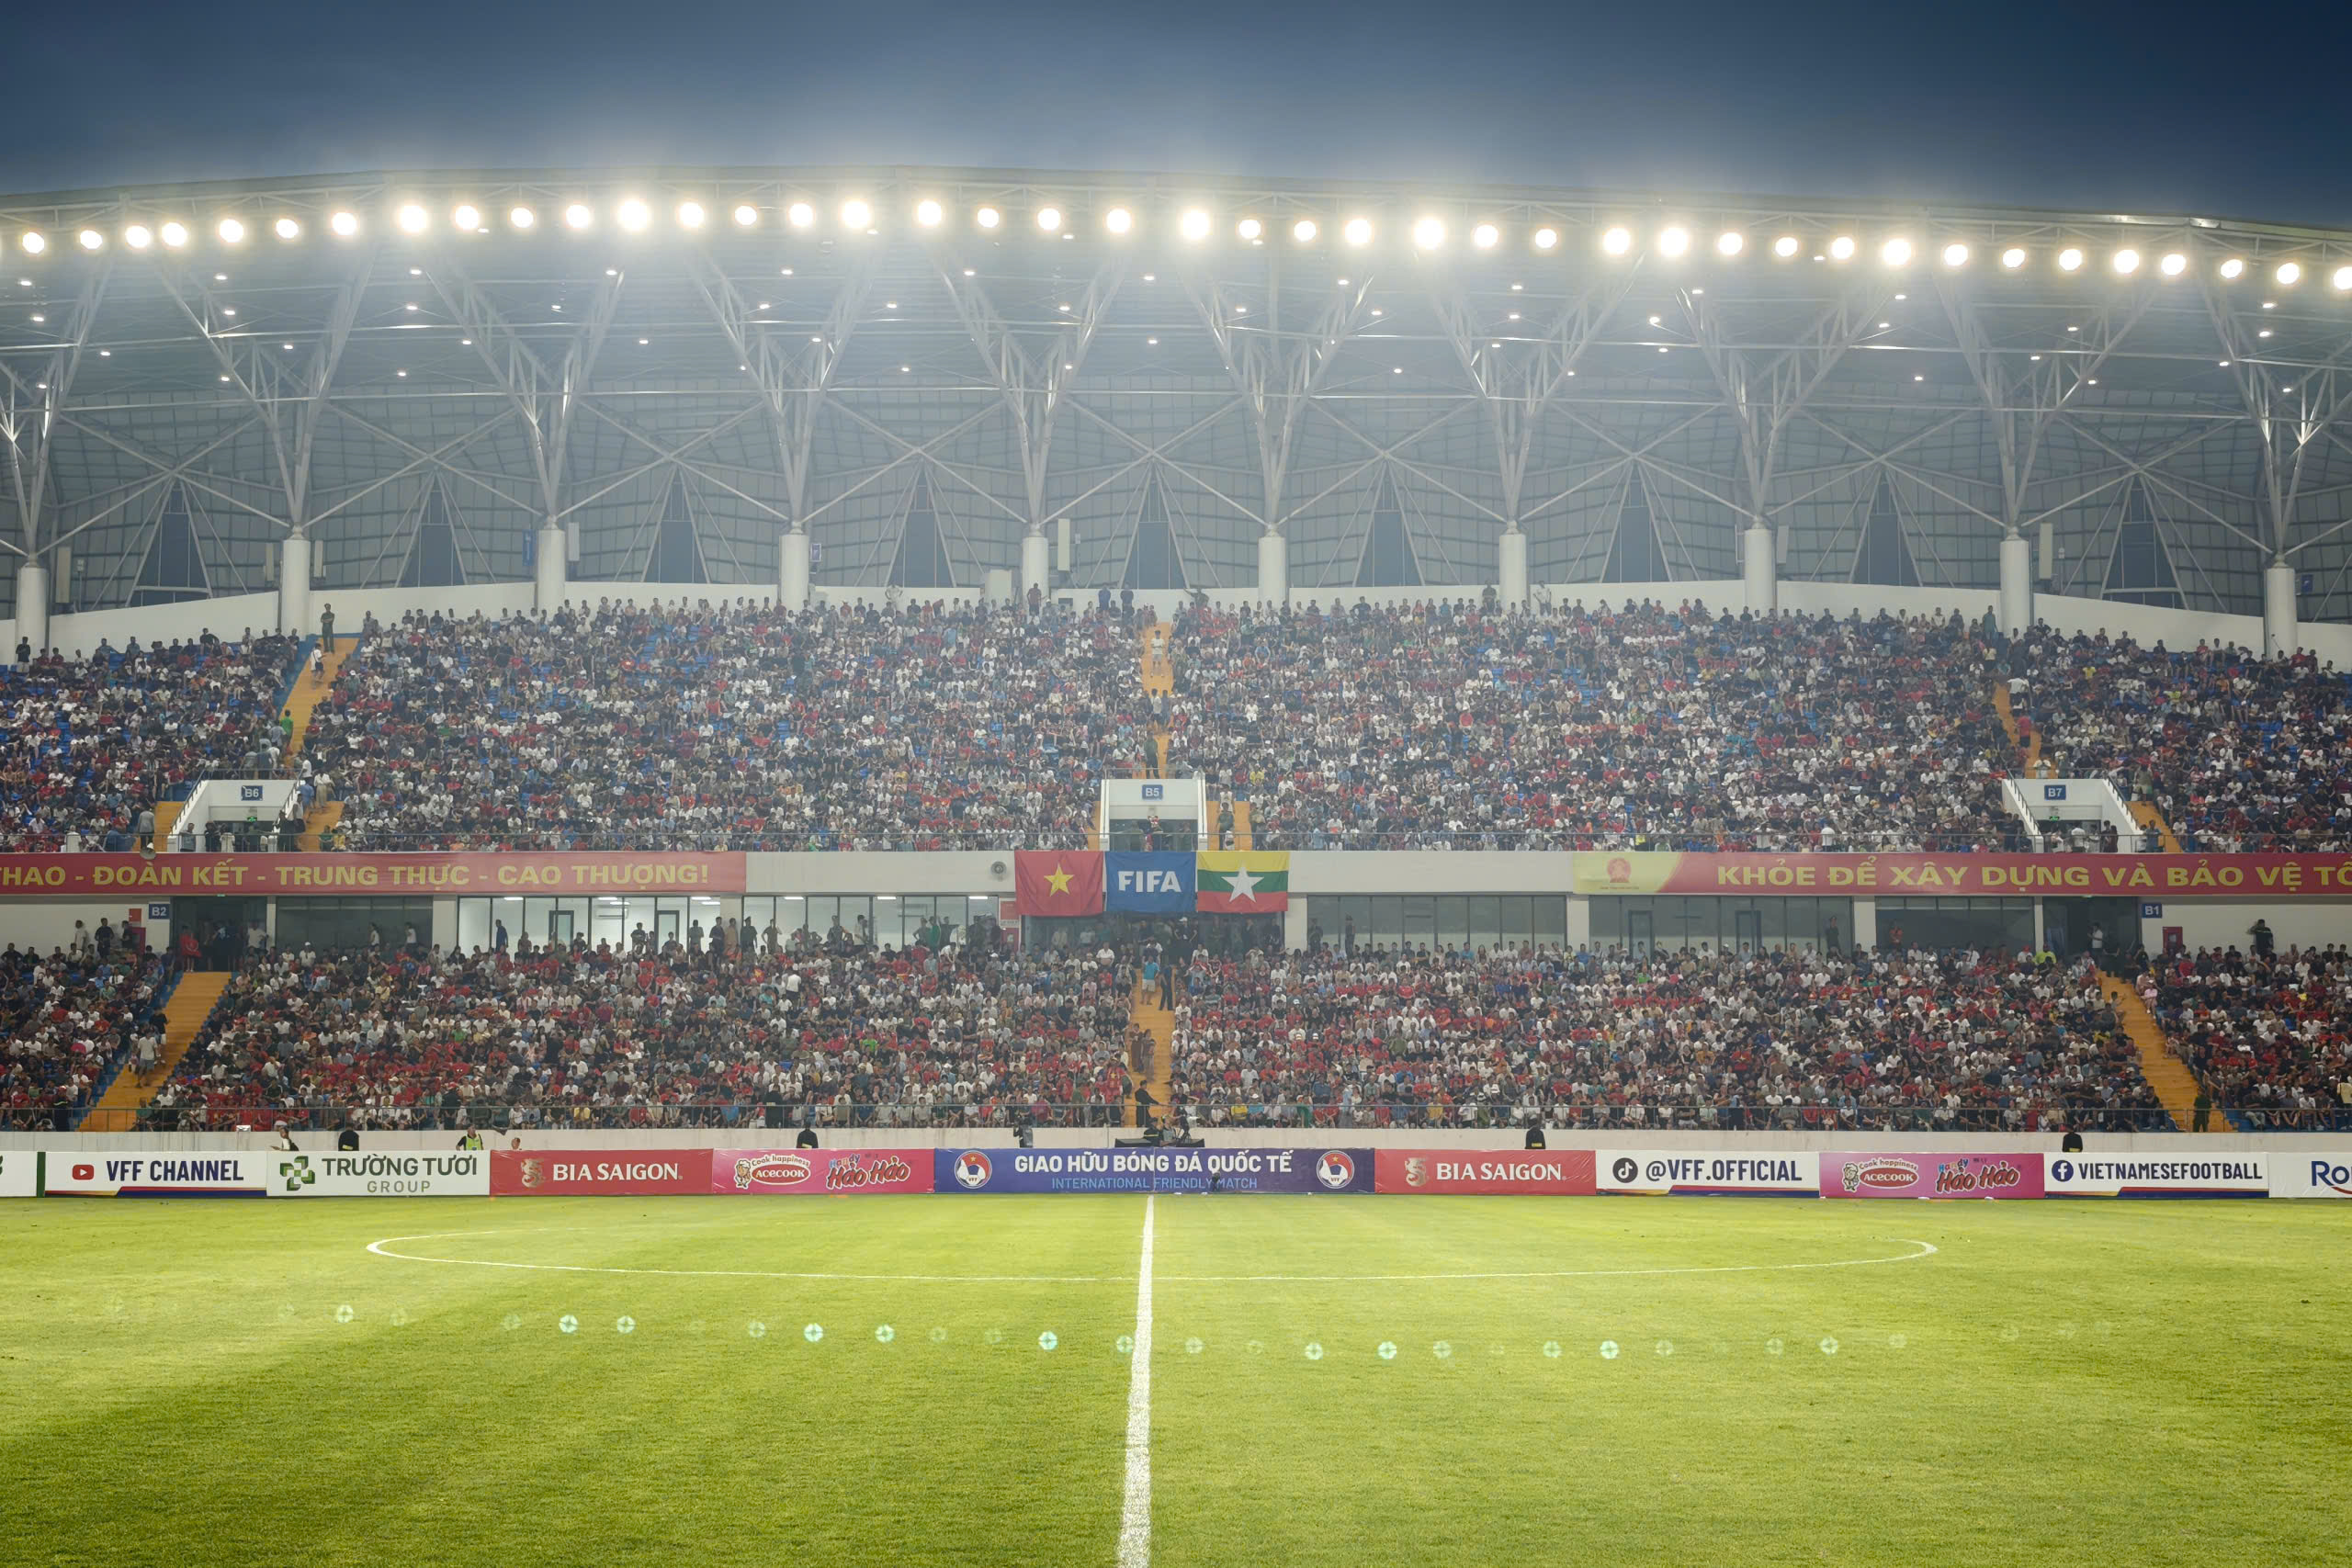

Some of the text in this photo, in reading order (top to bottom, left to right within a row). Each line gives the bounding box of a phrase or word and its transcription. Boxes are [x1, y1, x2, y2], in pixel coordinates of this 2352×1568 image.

[244, 787, 260, 798] B6
[1145, 787, 1160, 797] B5
[2048, 787, 2063, 798] B7
[0, 866, 66, 886] HAO
[93, 863, 181, 886] ĐOÀN
[192, 858, 249, 886] KẾT
[275, 867, 379, 886] TRUNG
[389, 863, 469, 891] THỰC
[498, 866, 561, 885] CAO
[571, 863, 708, 890] THƯỢNG!
[1118, 871, 1182, 893] FIFA
[1717, 859, 1815, 886] KHỎE
[1826, 856, 1877, 886] ĐỂ
[1888, 861, 1968, 886] XÂY
[1982, 863, 2089, 892] DỰNG
[2102, 862, 2154, 887] VÀ
[2167, 858, 2244, 887] BẢO
[2256, 862, 2302, 892] VỆ
[152, 907, 166, 917] B2
[2145, 906, 2159, 917] B1
[322, 1154, 477, 1176] TRƯỜNG TƯƠI
[752, 1154, 810, 1167] Cook happiness
[1014, 1148, 1294, 1174] GIAO HỮU BÓNG ĐÁ QUỐC TẾ
[1859, 1158, 1918, 1170] Cook happiness
[107, 1160, 244, 1181] VFF CHANNEL
[552, 1163, 678, 1181] BIA SAIGON
[827, 1156, 910, 1189] Hảo Hảo
[1437, 1163, 1562, 1180] BIA SAIGON
[1646, 1159, 1802, 1181] @VFF.OFFICIAL
[1936, 1161, 2020, 1192] Hảo Hảo
[2078, 1162, 2262, 1179] VIETNAMESEFOOTBALL
[2312, 1161, 2352, 1186] Ro
[367, 1179, 431, 1193] GROUP
[1052, 1178, 1149, 1190] INTERNATIONAL
[1154, 1178, 1213, 1190] FRIENDLY
